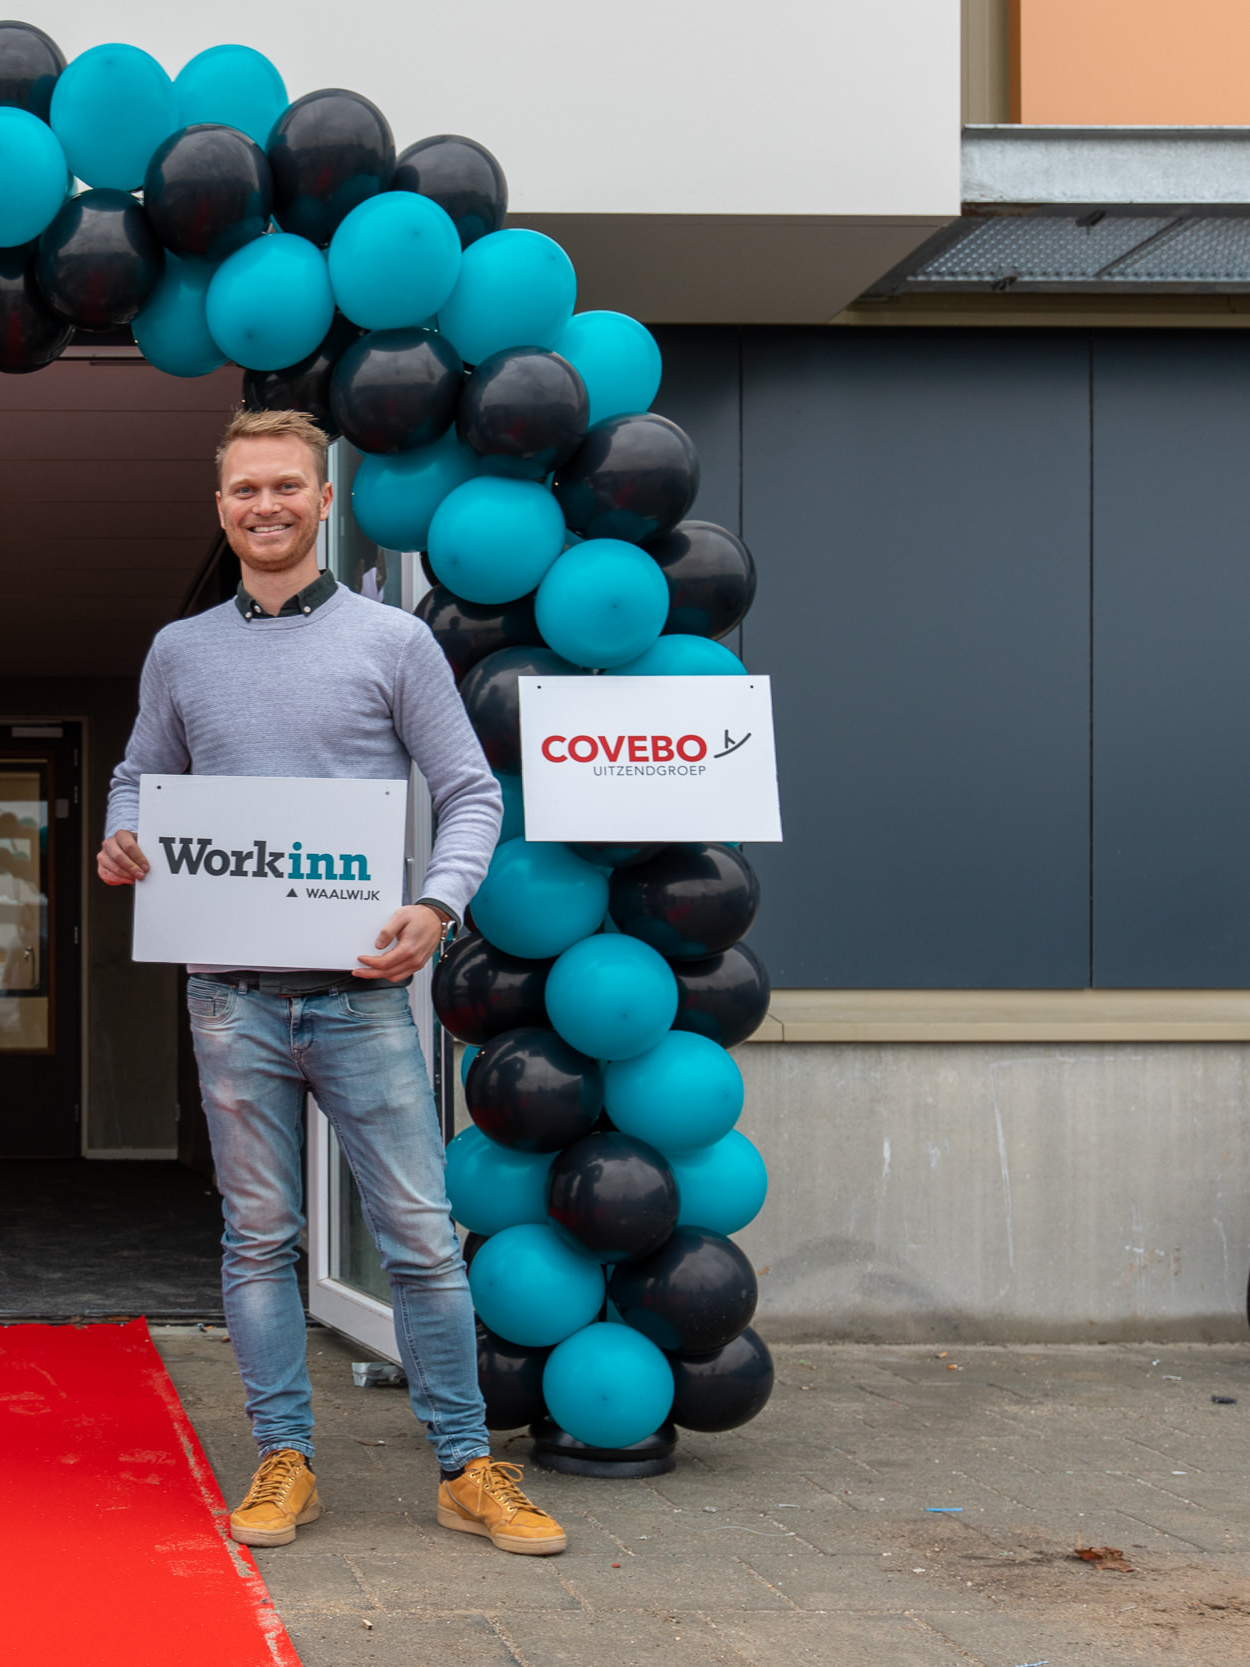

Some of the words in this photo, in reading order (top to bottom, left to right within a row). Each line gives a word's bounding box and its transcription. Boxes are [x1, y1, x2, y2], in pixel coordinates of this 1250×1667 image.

[541, 734, 707, 763] COVEBO
[593, 765, 707, 777] UITZENDGROEP
[158, 836, 371, 881] Workinn
[305, 888, 381, 901] WAALWIJK
